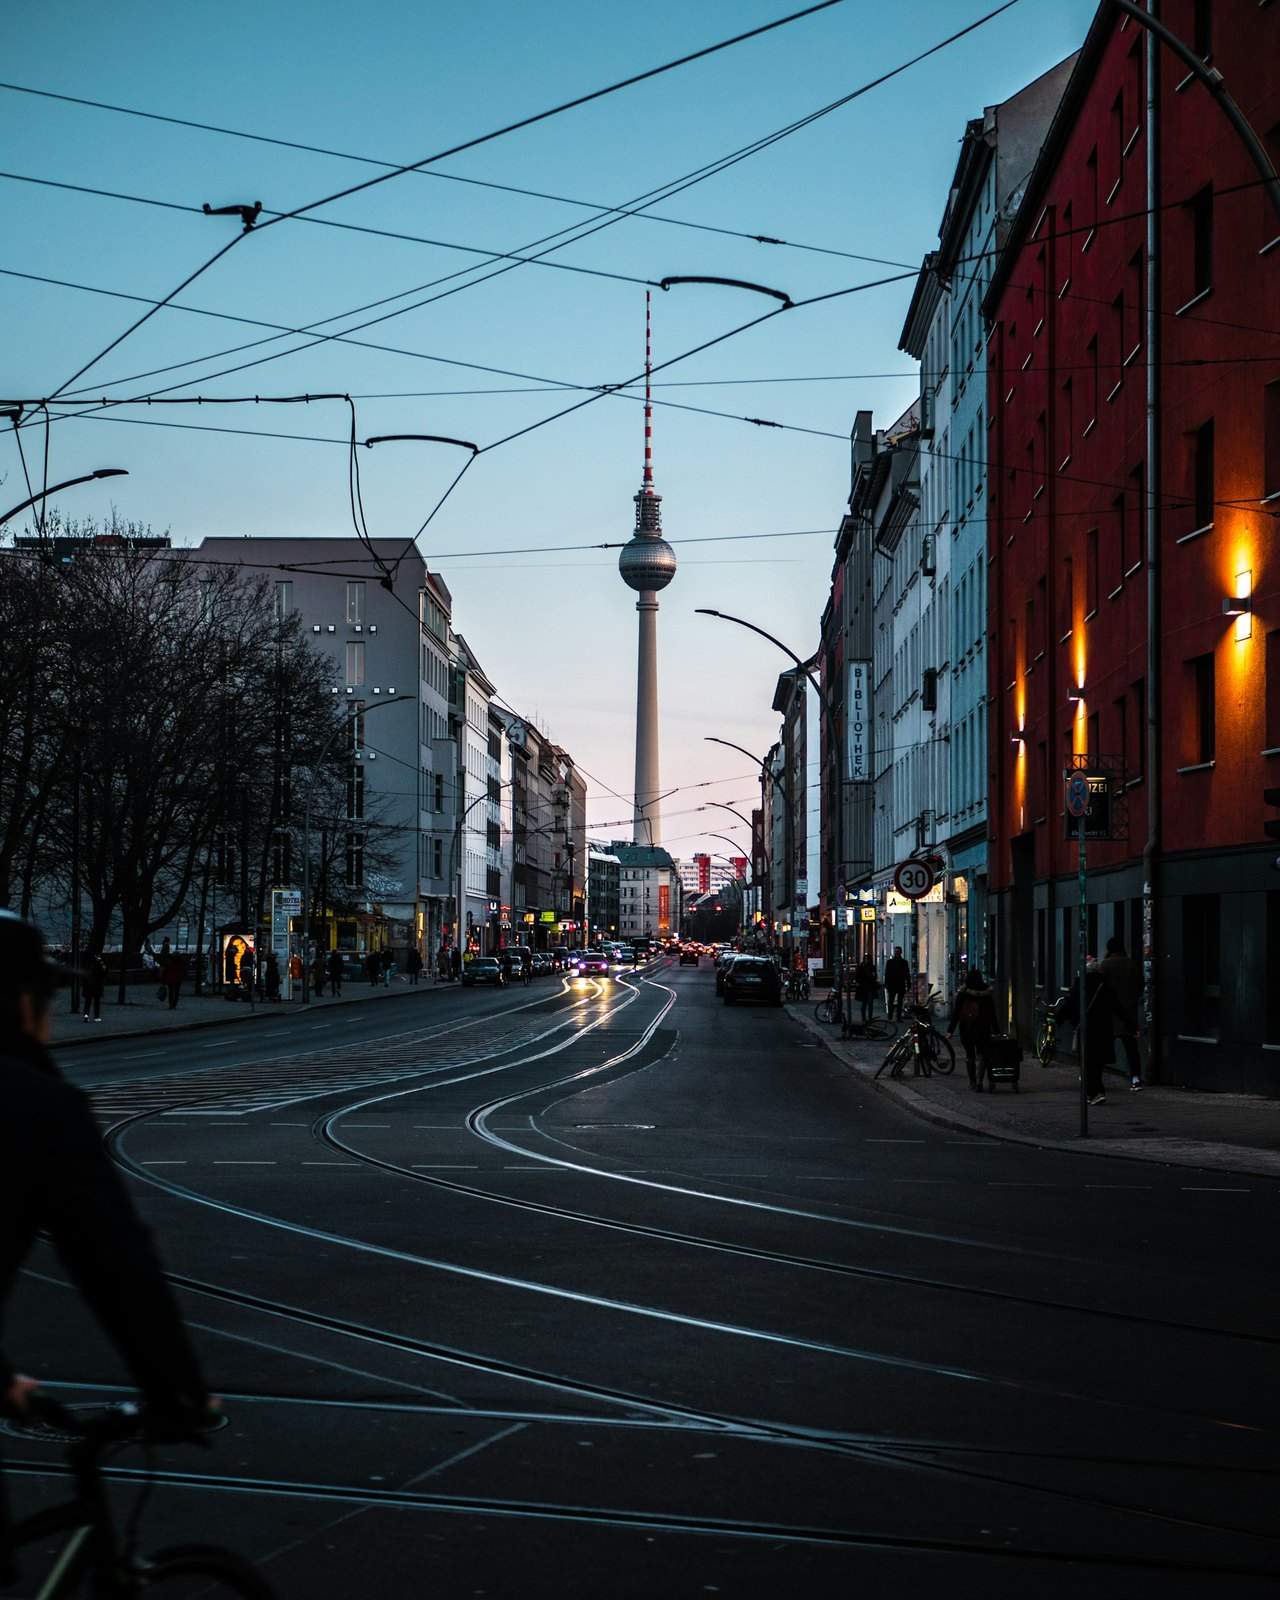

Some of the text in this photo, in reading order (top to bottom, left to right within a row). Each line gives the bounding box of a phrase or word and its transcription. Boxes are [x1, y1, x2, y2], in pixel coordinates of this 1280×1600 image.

[854, 668, 863, 775] BIBLIOTHEK
[902, 870, 926, 888] 30
[490, 902, 497, 910] U
[864, 909, 873, 918] EC
